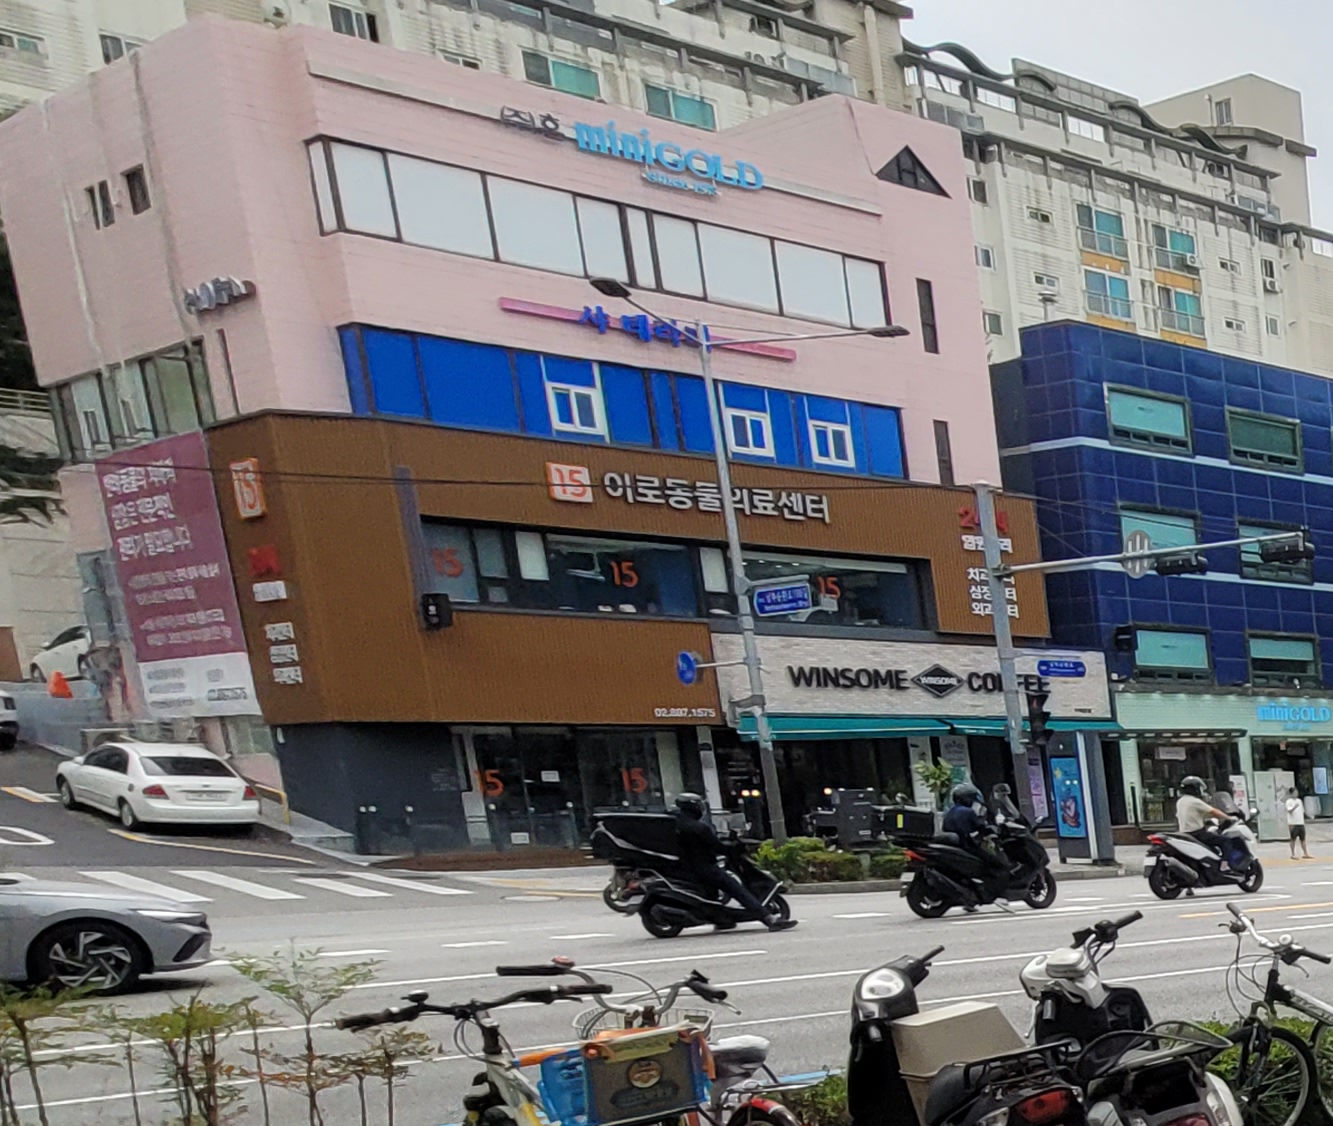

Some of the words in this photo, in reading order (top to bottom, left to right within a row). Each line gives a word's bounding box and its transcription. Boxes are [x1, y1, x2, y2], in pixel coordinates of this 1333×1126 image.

[611, 561, 639, 588] 15
[788, 665, 911, 691] WINSOME
[1257, 701, 1332, 723] miniGOLD
